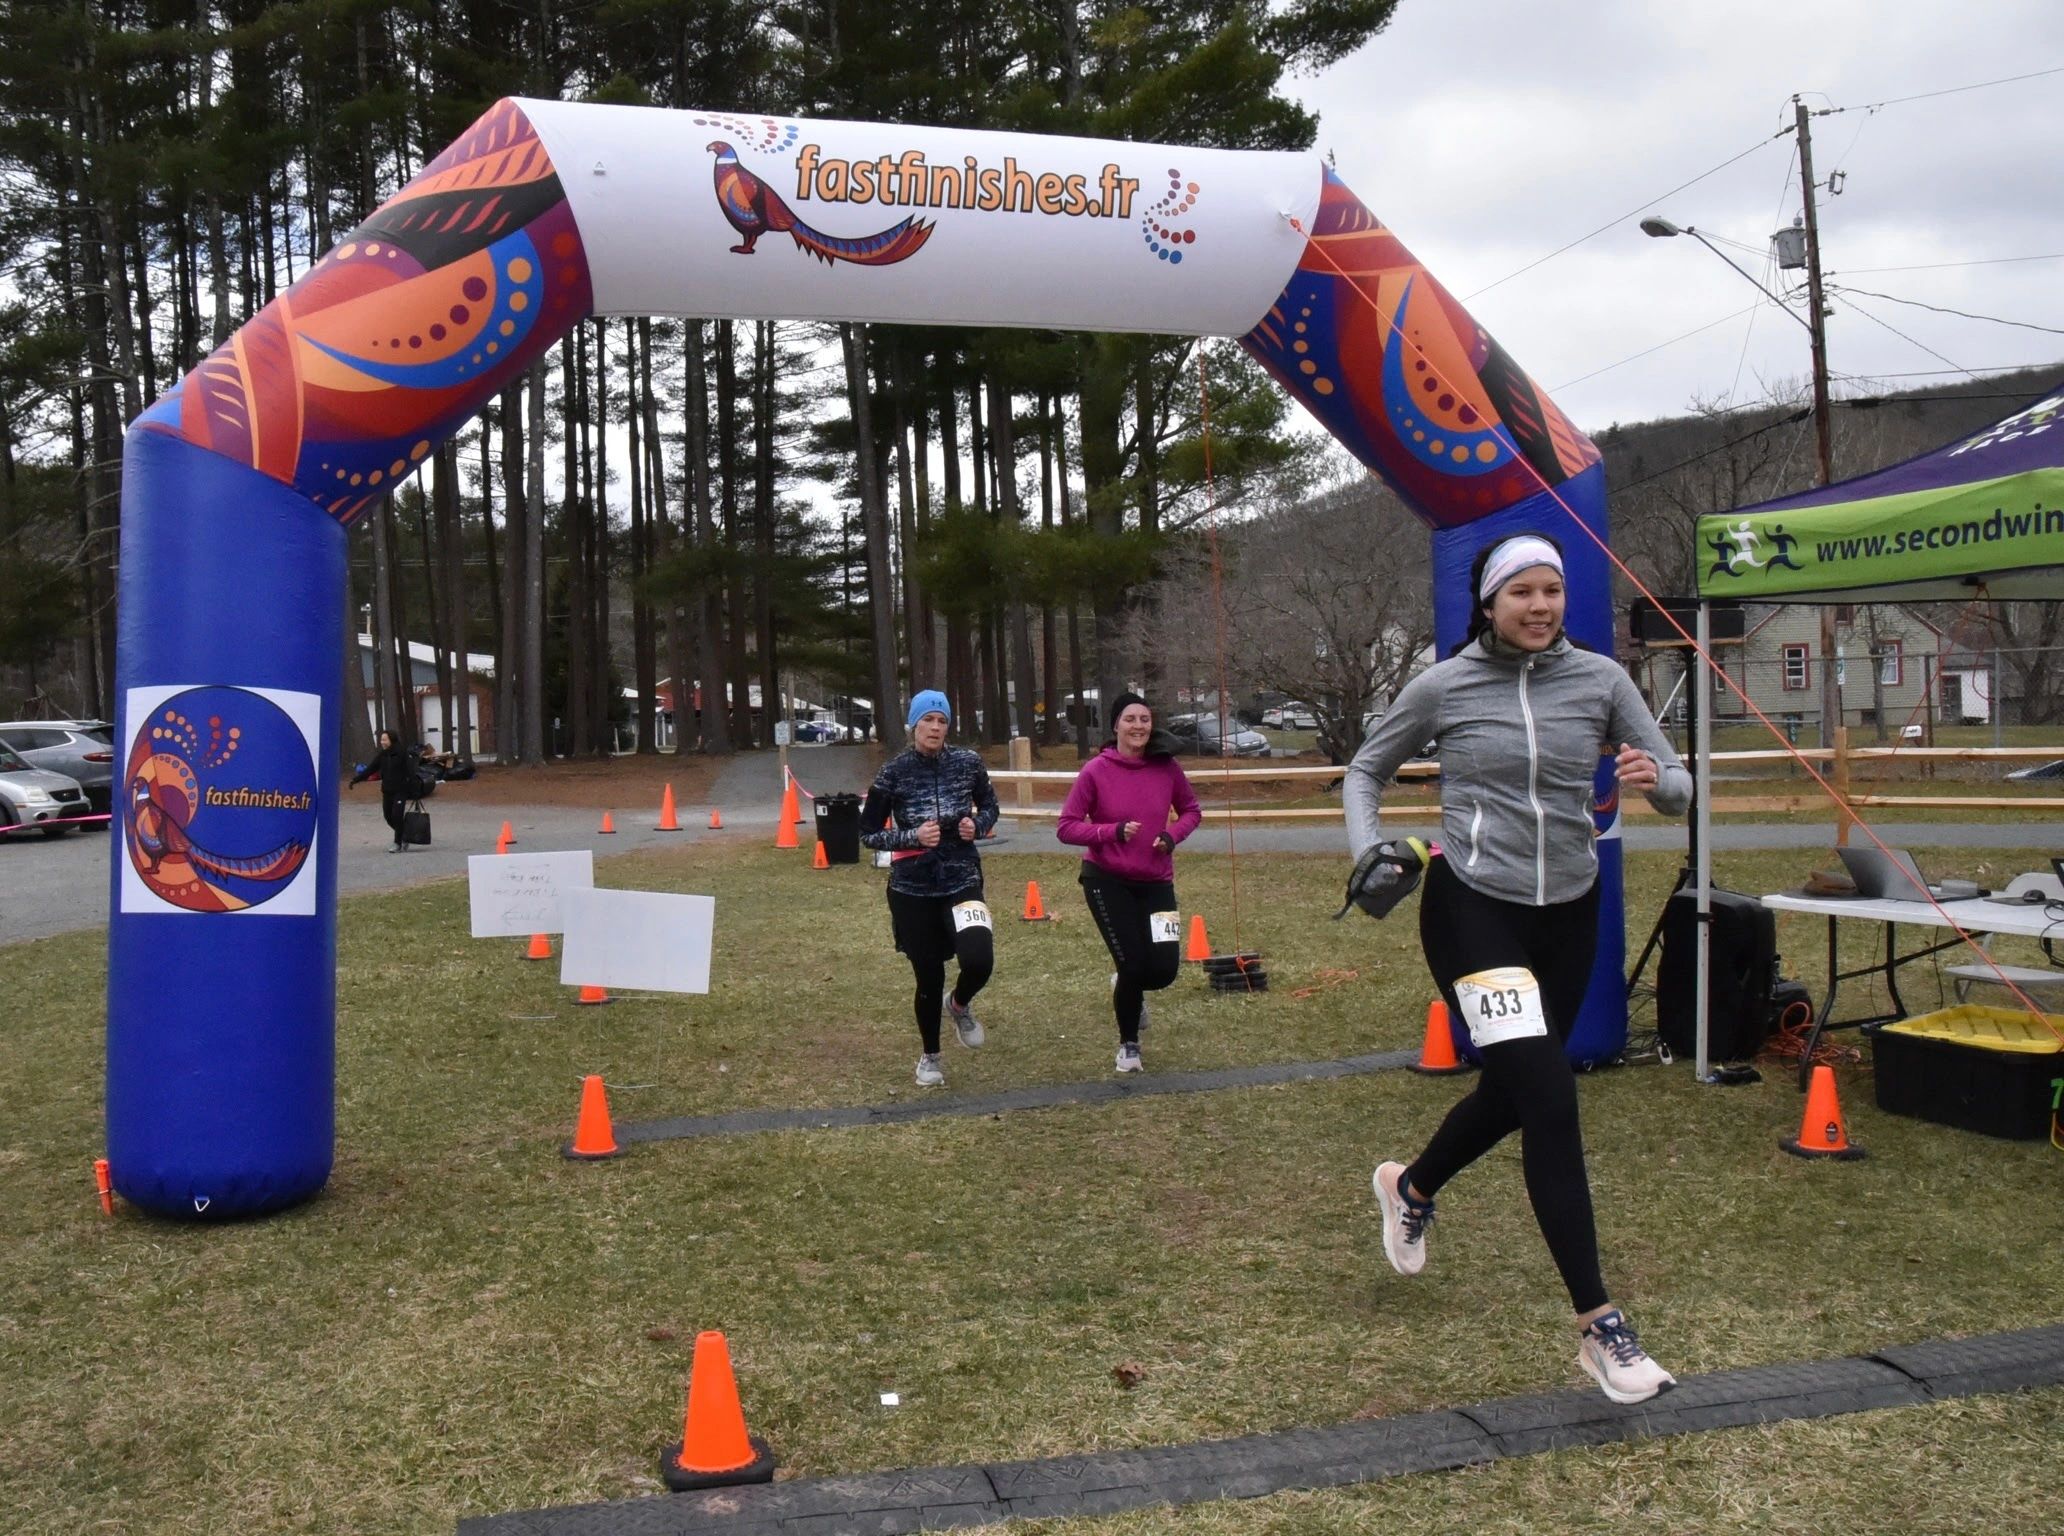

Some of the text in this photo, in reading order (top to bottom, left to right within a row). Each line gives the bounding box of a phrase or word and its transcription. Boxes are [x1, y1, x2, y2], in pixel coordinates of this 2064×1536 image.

[796, 143, 1139, 219] fastfinishes.fr
[1817, 503, 2064, 563] www.secondwin
[205, 786, 311, 810] fastfinishes.fr
[1480, 988, 1522, 1019] 433
